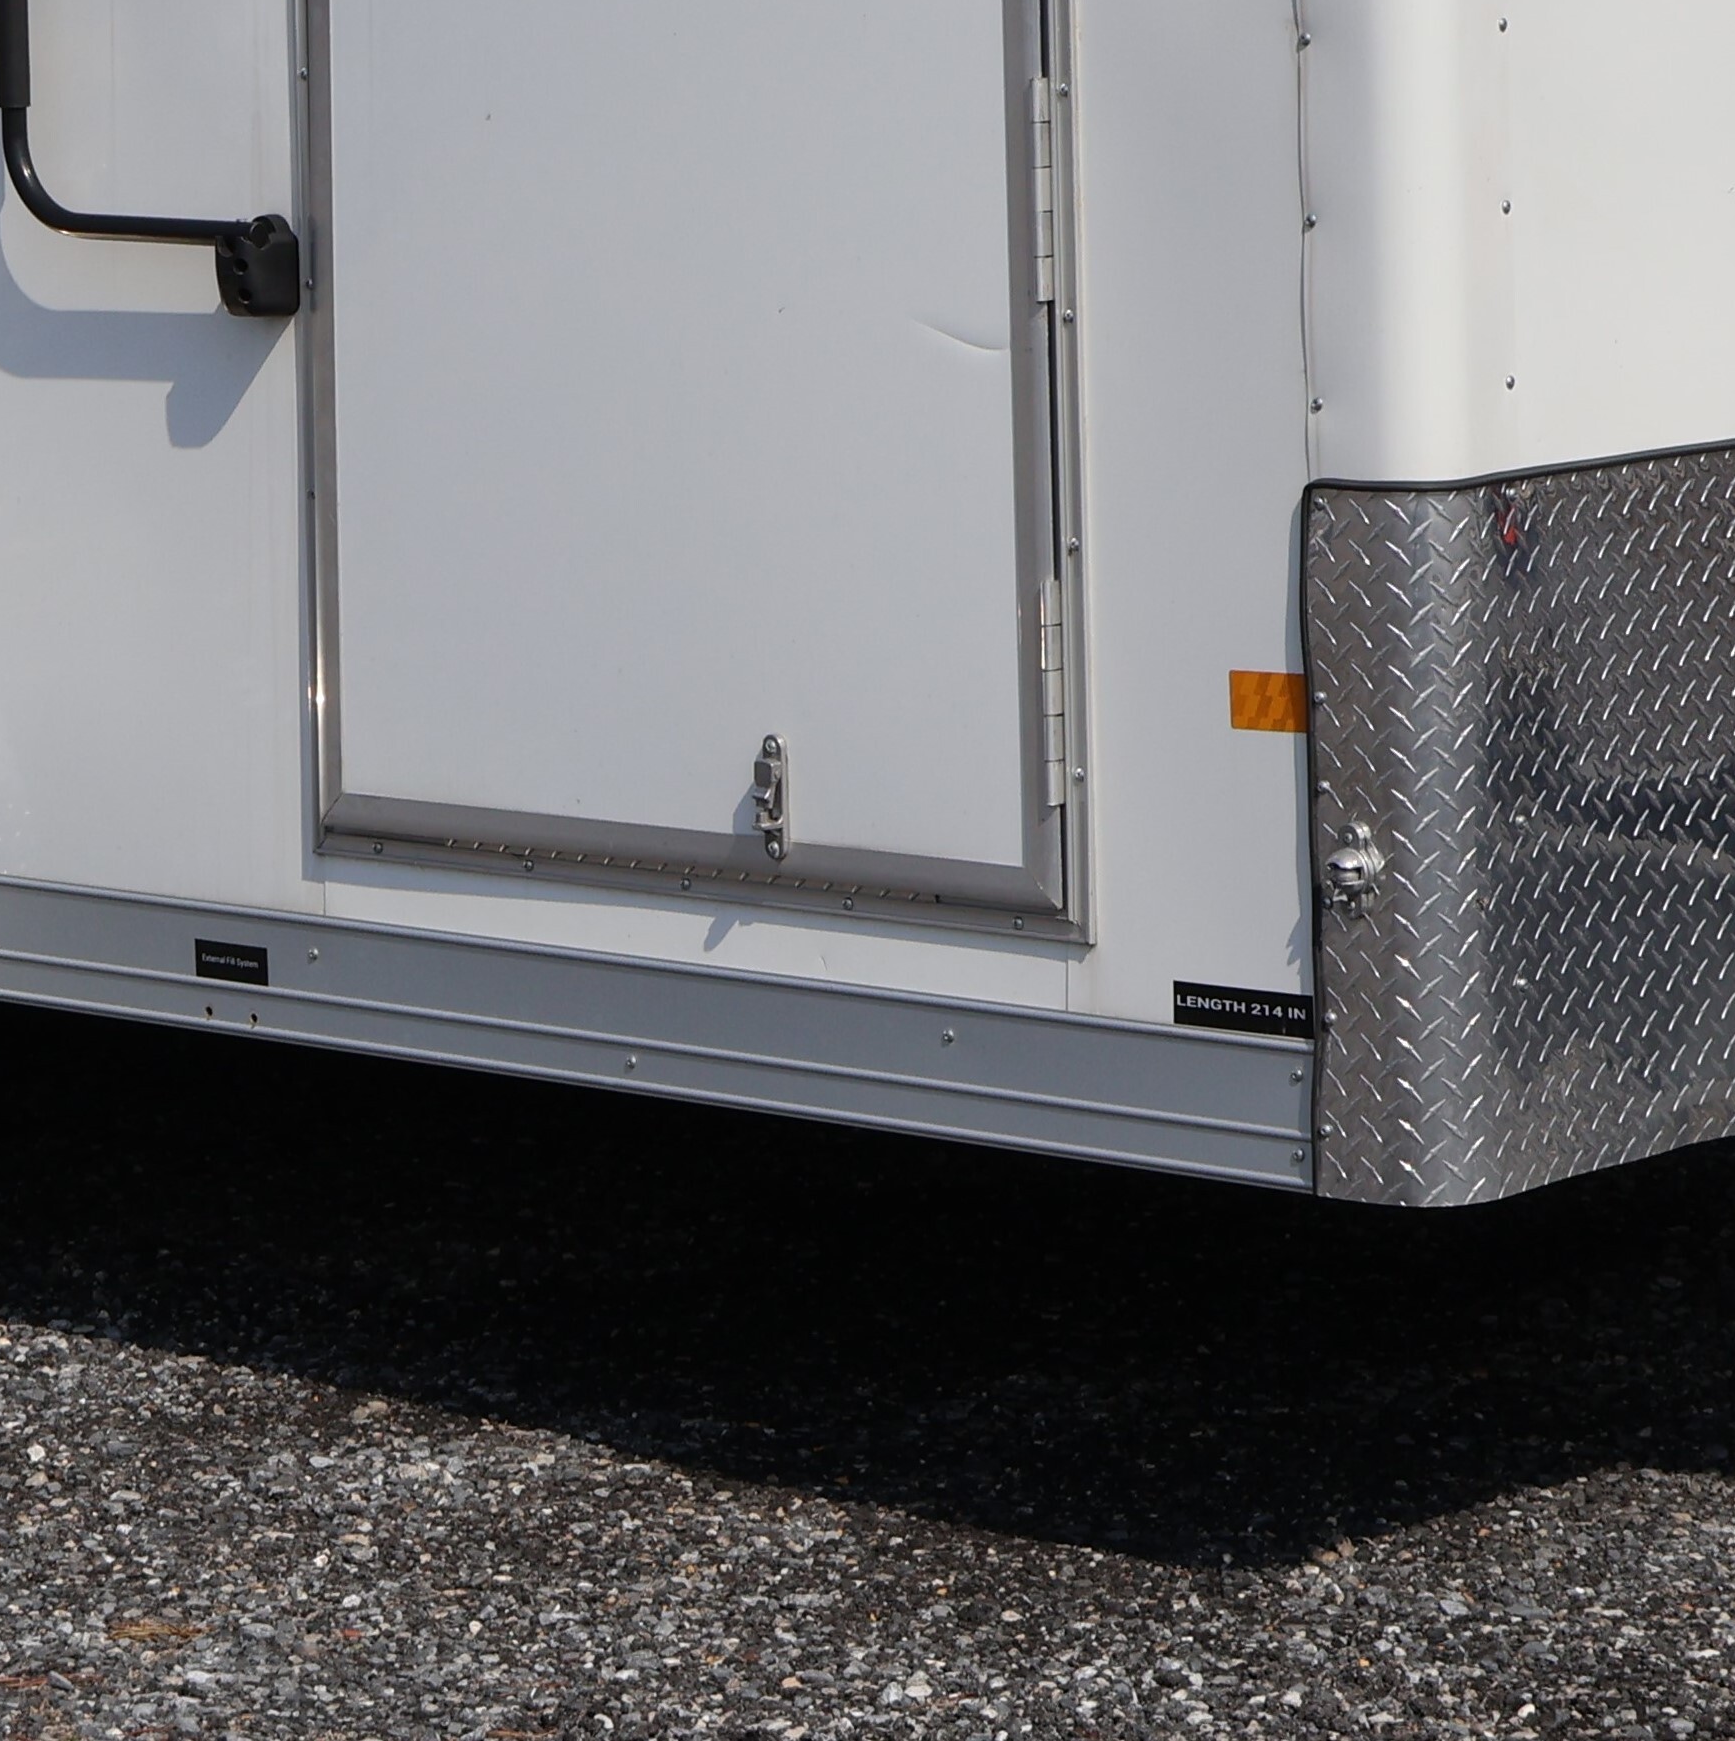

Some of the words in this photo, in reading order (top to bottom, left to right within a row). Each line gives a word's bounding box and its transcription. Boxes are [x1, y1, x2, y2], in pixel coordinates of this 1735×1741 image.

[1176, 994, 1246, 1014] LENGTH
[1251, 1003, 1283, 1019] 214
[1288, 1007, 1306, 1020] IN
